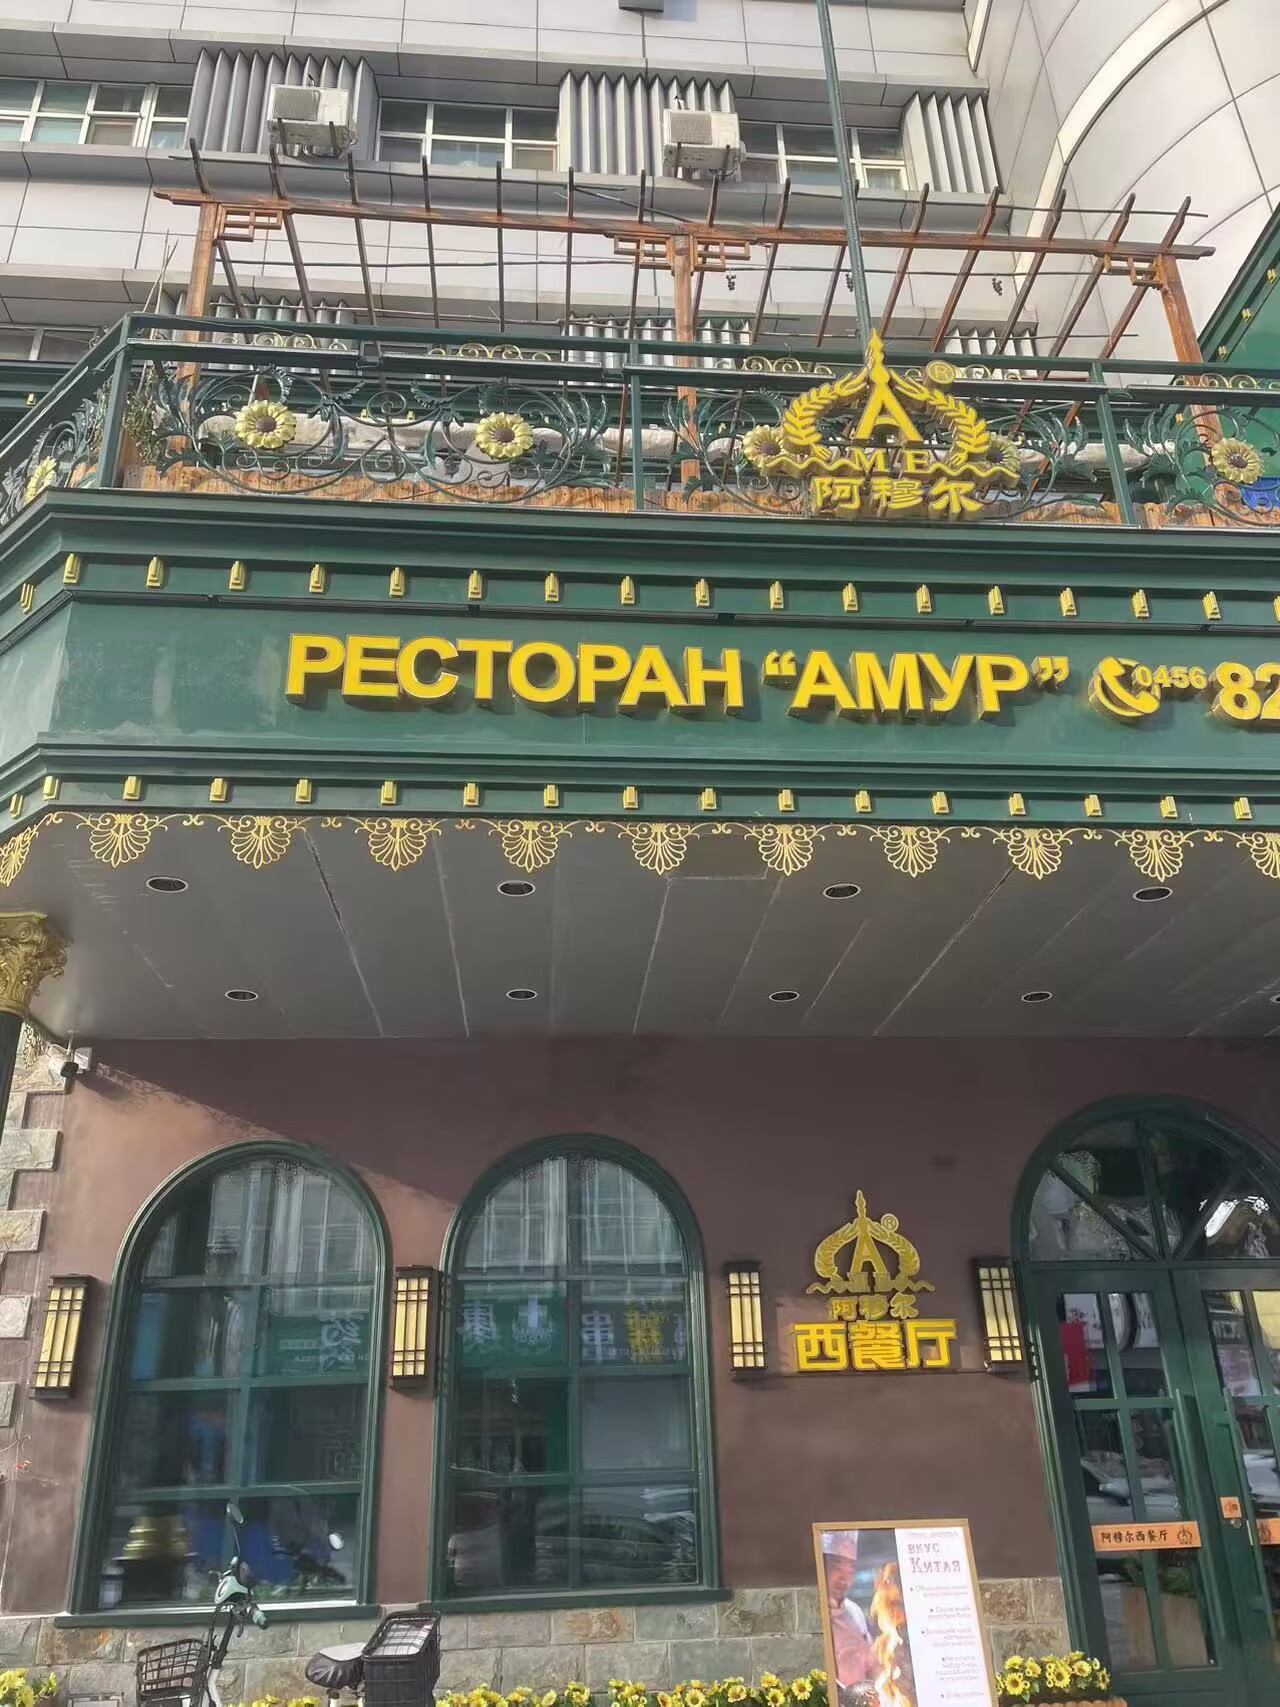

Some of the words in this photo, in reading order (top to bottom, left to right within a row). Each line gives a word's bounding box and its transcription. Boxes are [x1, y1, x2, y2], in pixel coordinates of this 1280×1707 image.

[813, 476, 984, 514] 阿穆尔
[285, 634, 744, 708] РЕСТОРАН
[1136, 664, 1208, 690] 0456
[794, 1319, 956, 1371] 西餐厅
[1101, 1529, 1168, 1544] 阿穆尔西餐厅
